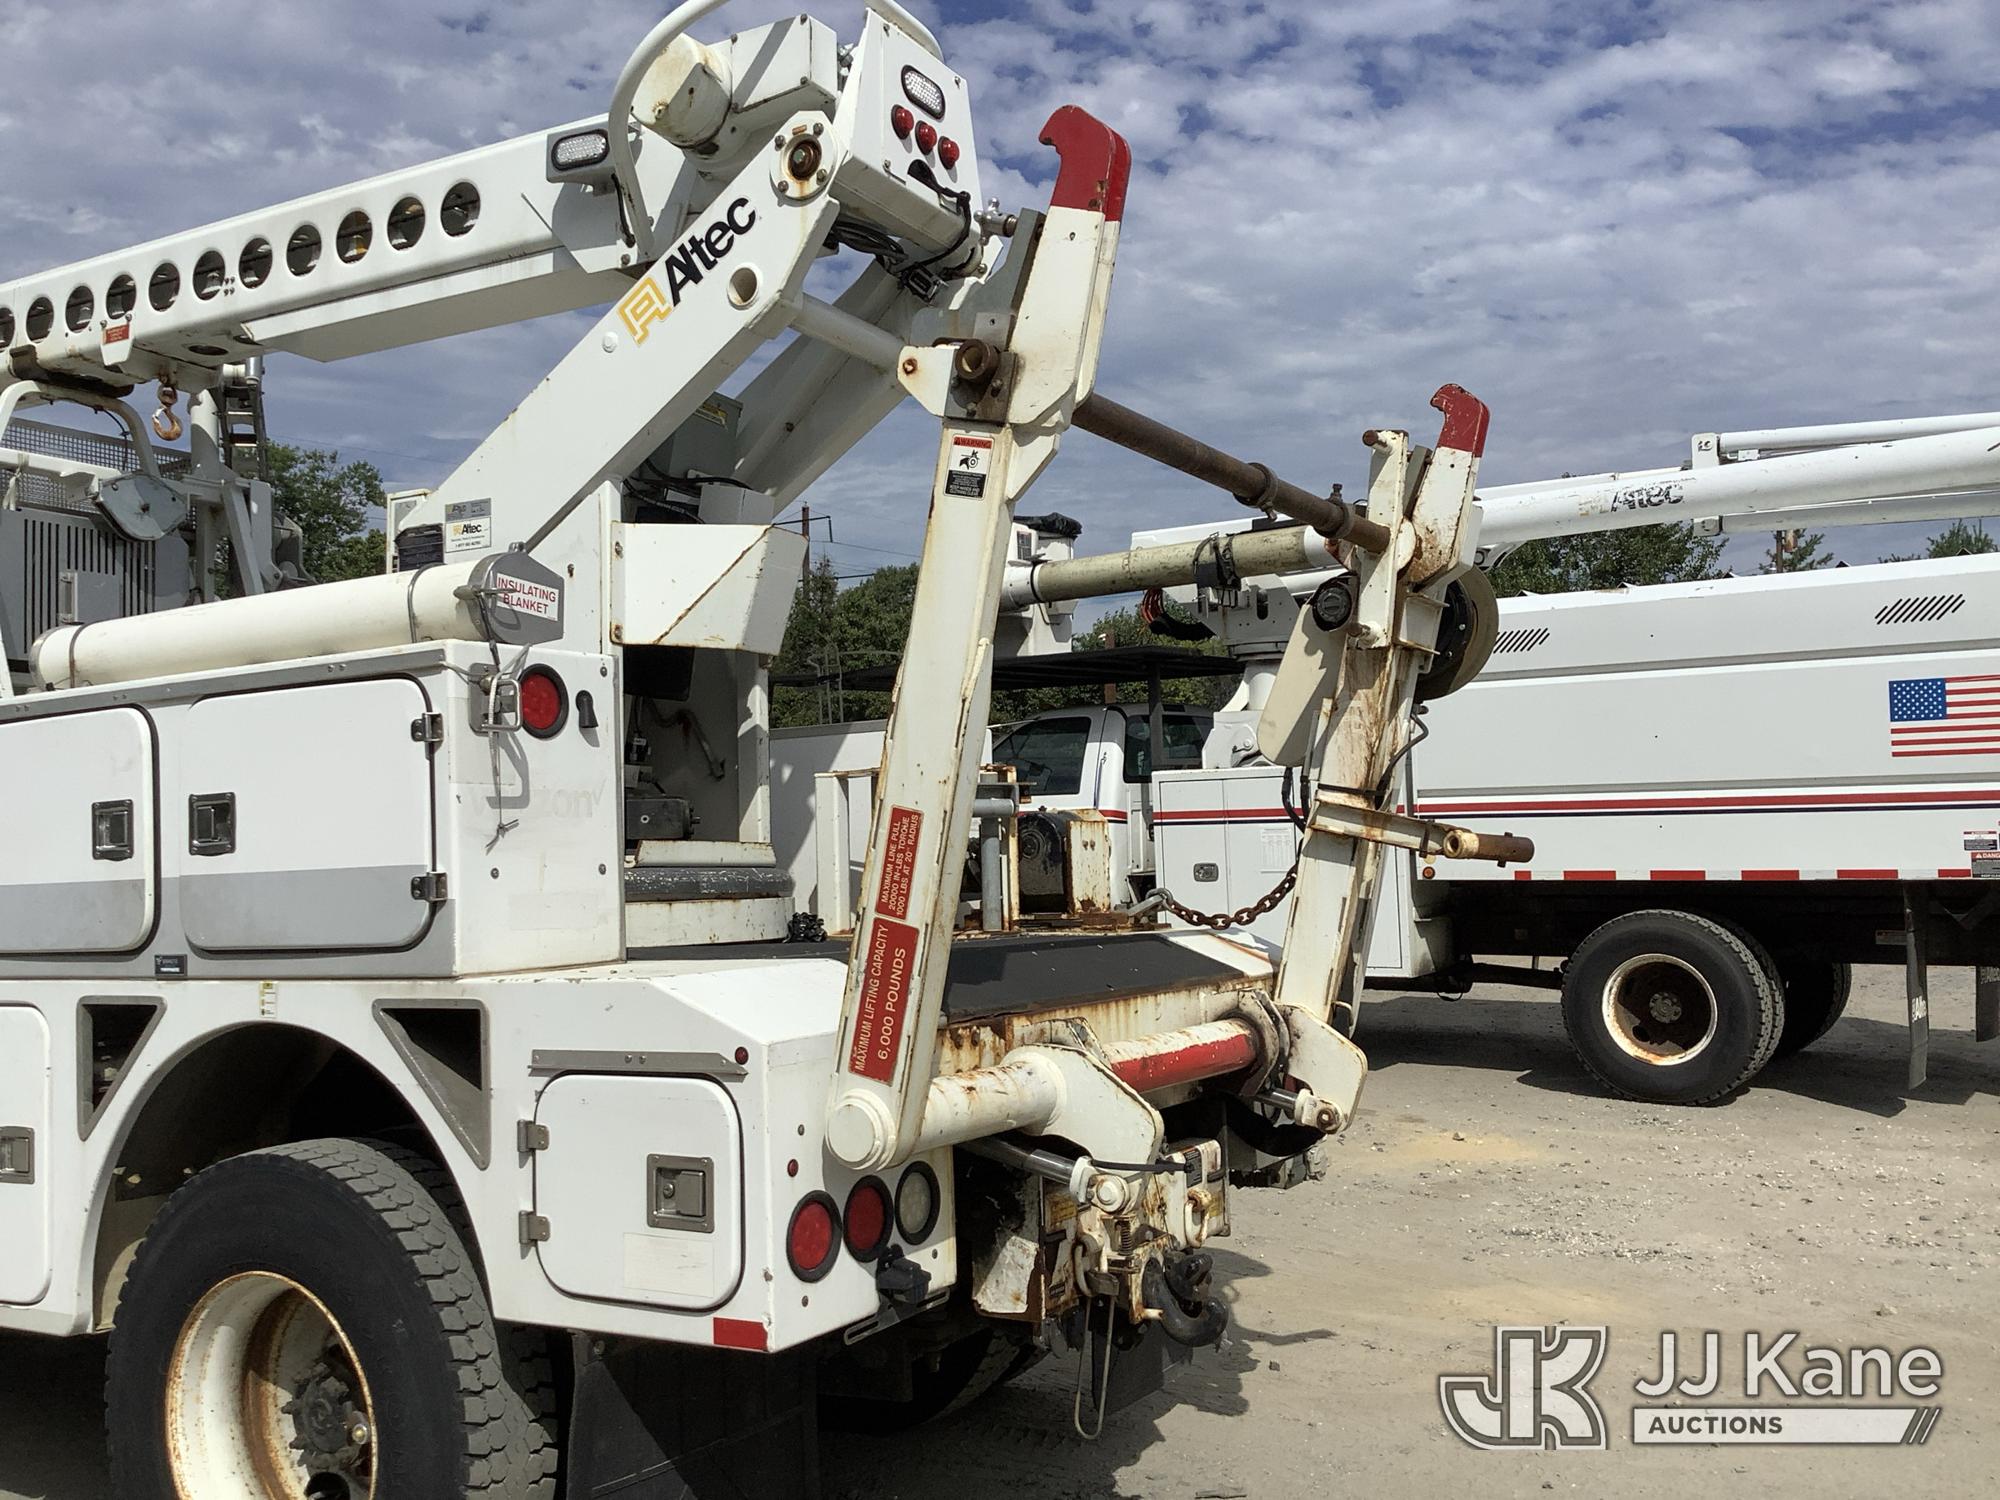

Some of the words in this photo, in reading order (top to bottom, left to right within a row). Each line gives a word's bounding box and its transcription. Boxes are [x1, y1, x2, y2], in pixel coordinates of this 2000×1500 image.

[665, 197, 756, 307] Altec
[461, 523, 482, 535] Altec
[496, 577, 556, 602] INSULATING
[503, 593, 549, 614] BLANKET
[891, 821, 901, 841] PULL
[898, 816, 910, 850] TORQUE
[907, 814, 919, 845] RADIUS
[888, 842, 897, 861] LINE
[893, 853, 904, 881] IN-LBS
[903, 865, 911, 876] AT
[881, 863, 894, 903] MAXIMUM
[889, 882, 899, 911] 20000
[900, 877, 909, 894] LBS
[896, 896, 906, 916] 1000
[871, 924, 889, 977] CAPACITY
[885, 947, 906, 1012] POUNDS
[864, 978, 880, 1019] LIFTING
[855, 1021, 873, 1072] MAXIMUM
[877, 1016, 894, 1060] 6,000
